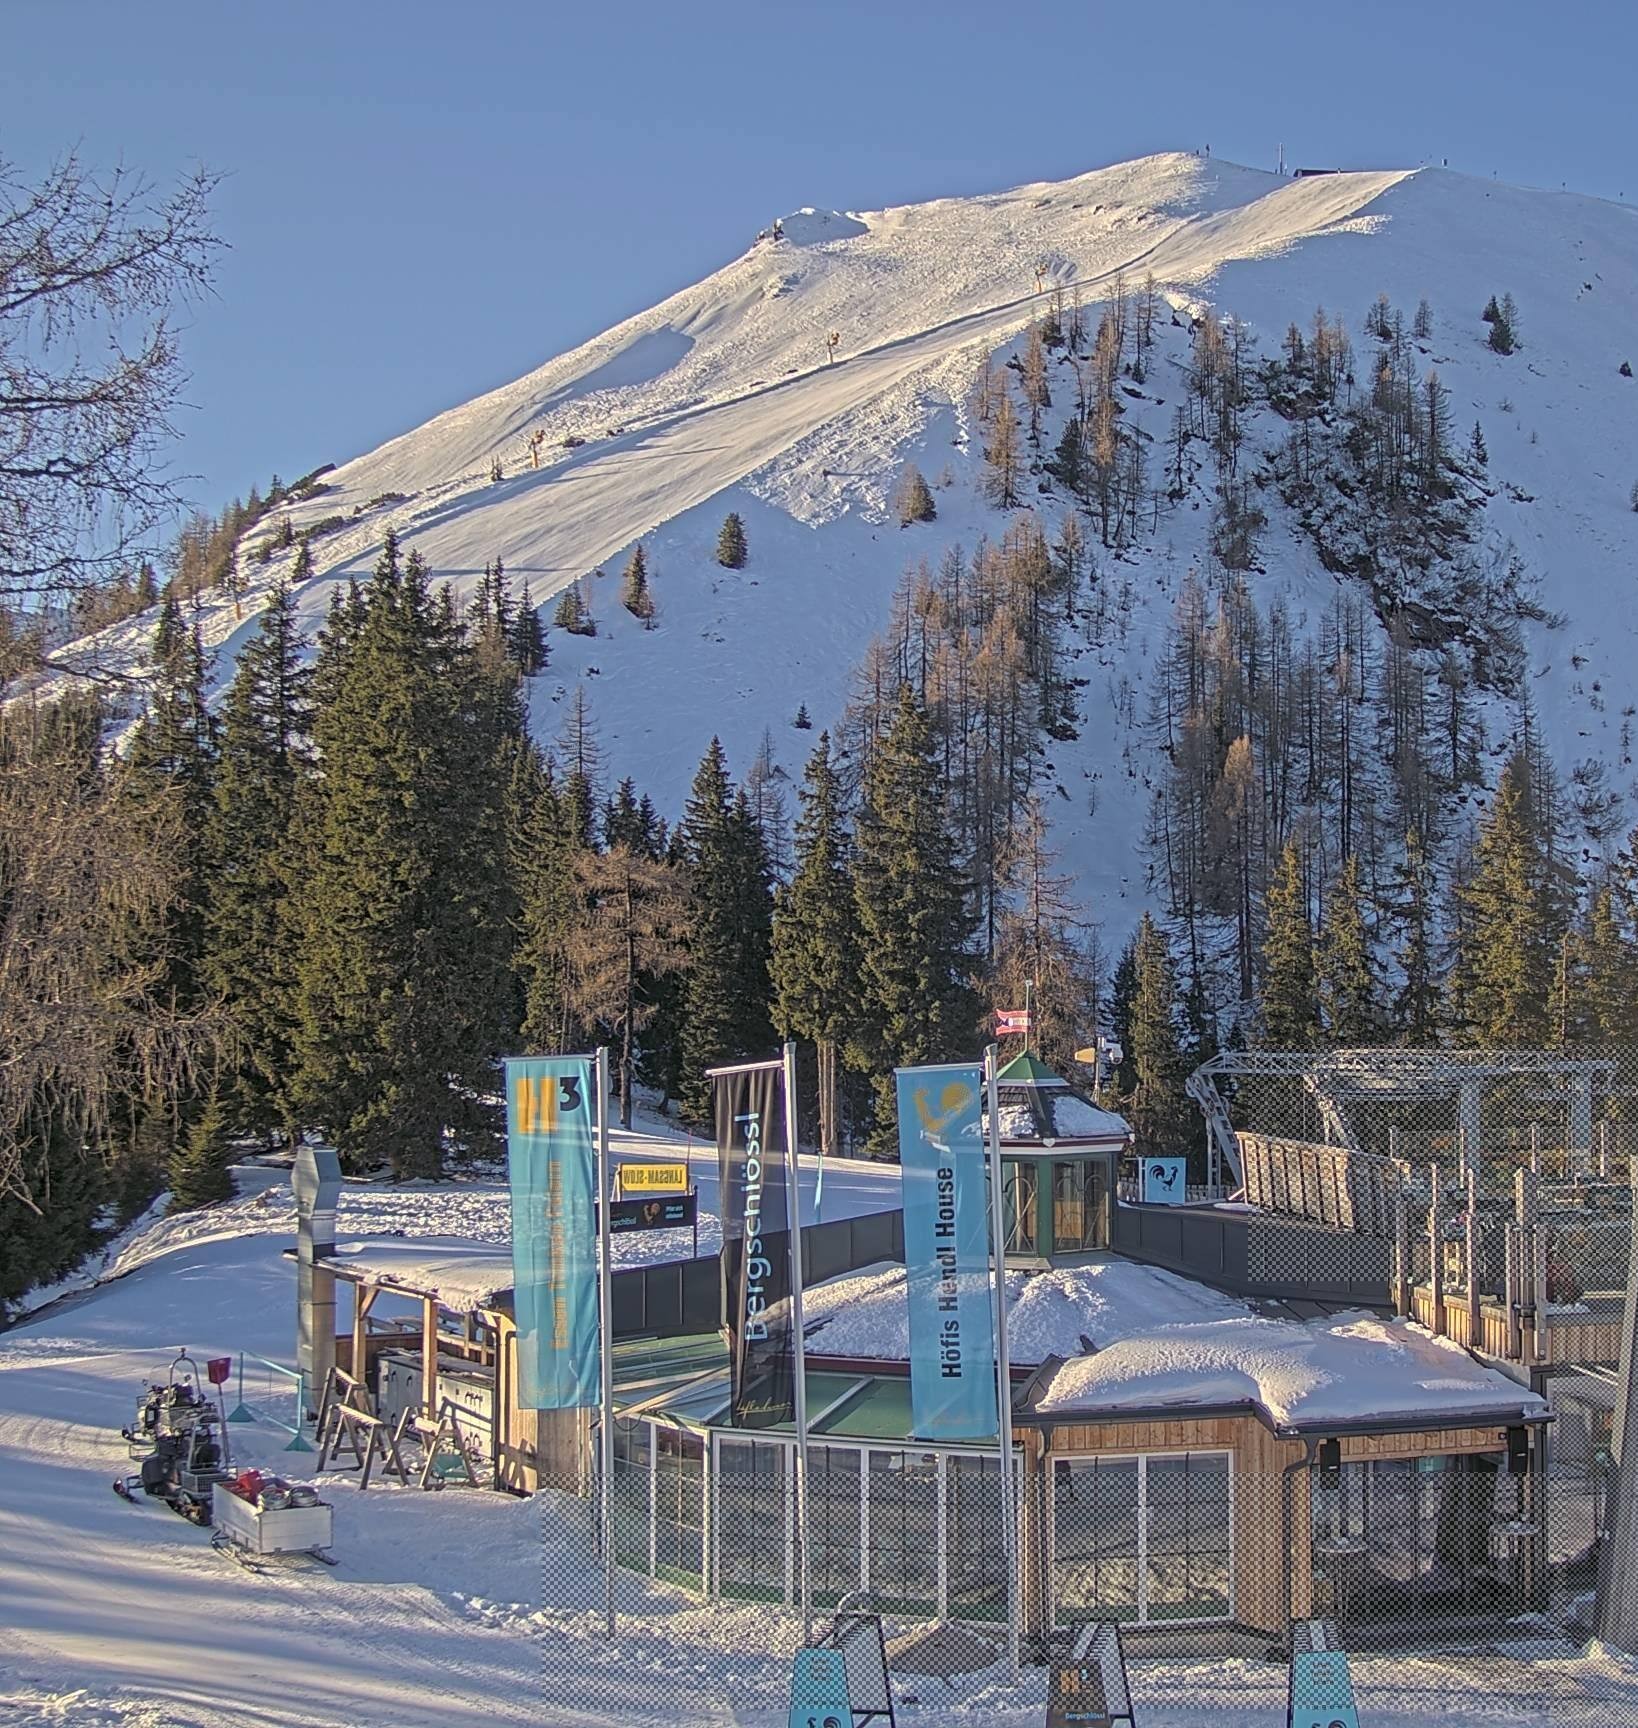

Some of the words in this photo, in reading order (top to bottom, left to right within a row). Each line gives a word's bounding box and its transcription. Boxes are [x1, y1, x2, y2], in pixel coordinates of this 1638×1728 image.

[934, 1167, 955, 1238] House
[937, 1245, 959, 1312] Hendl
[940, 1319, 963, 1379] Höfis
